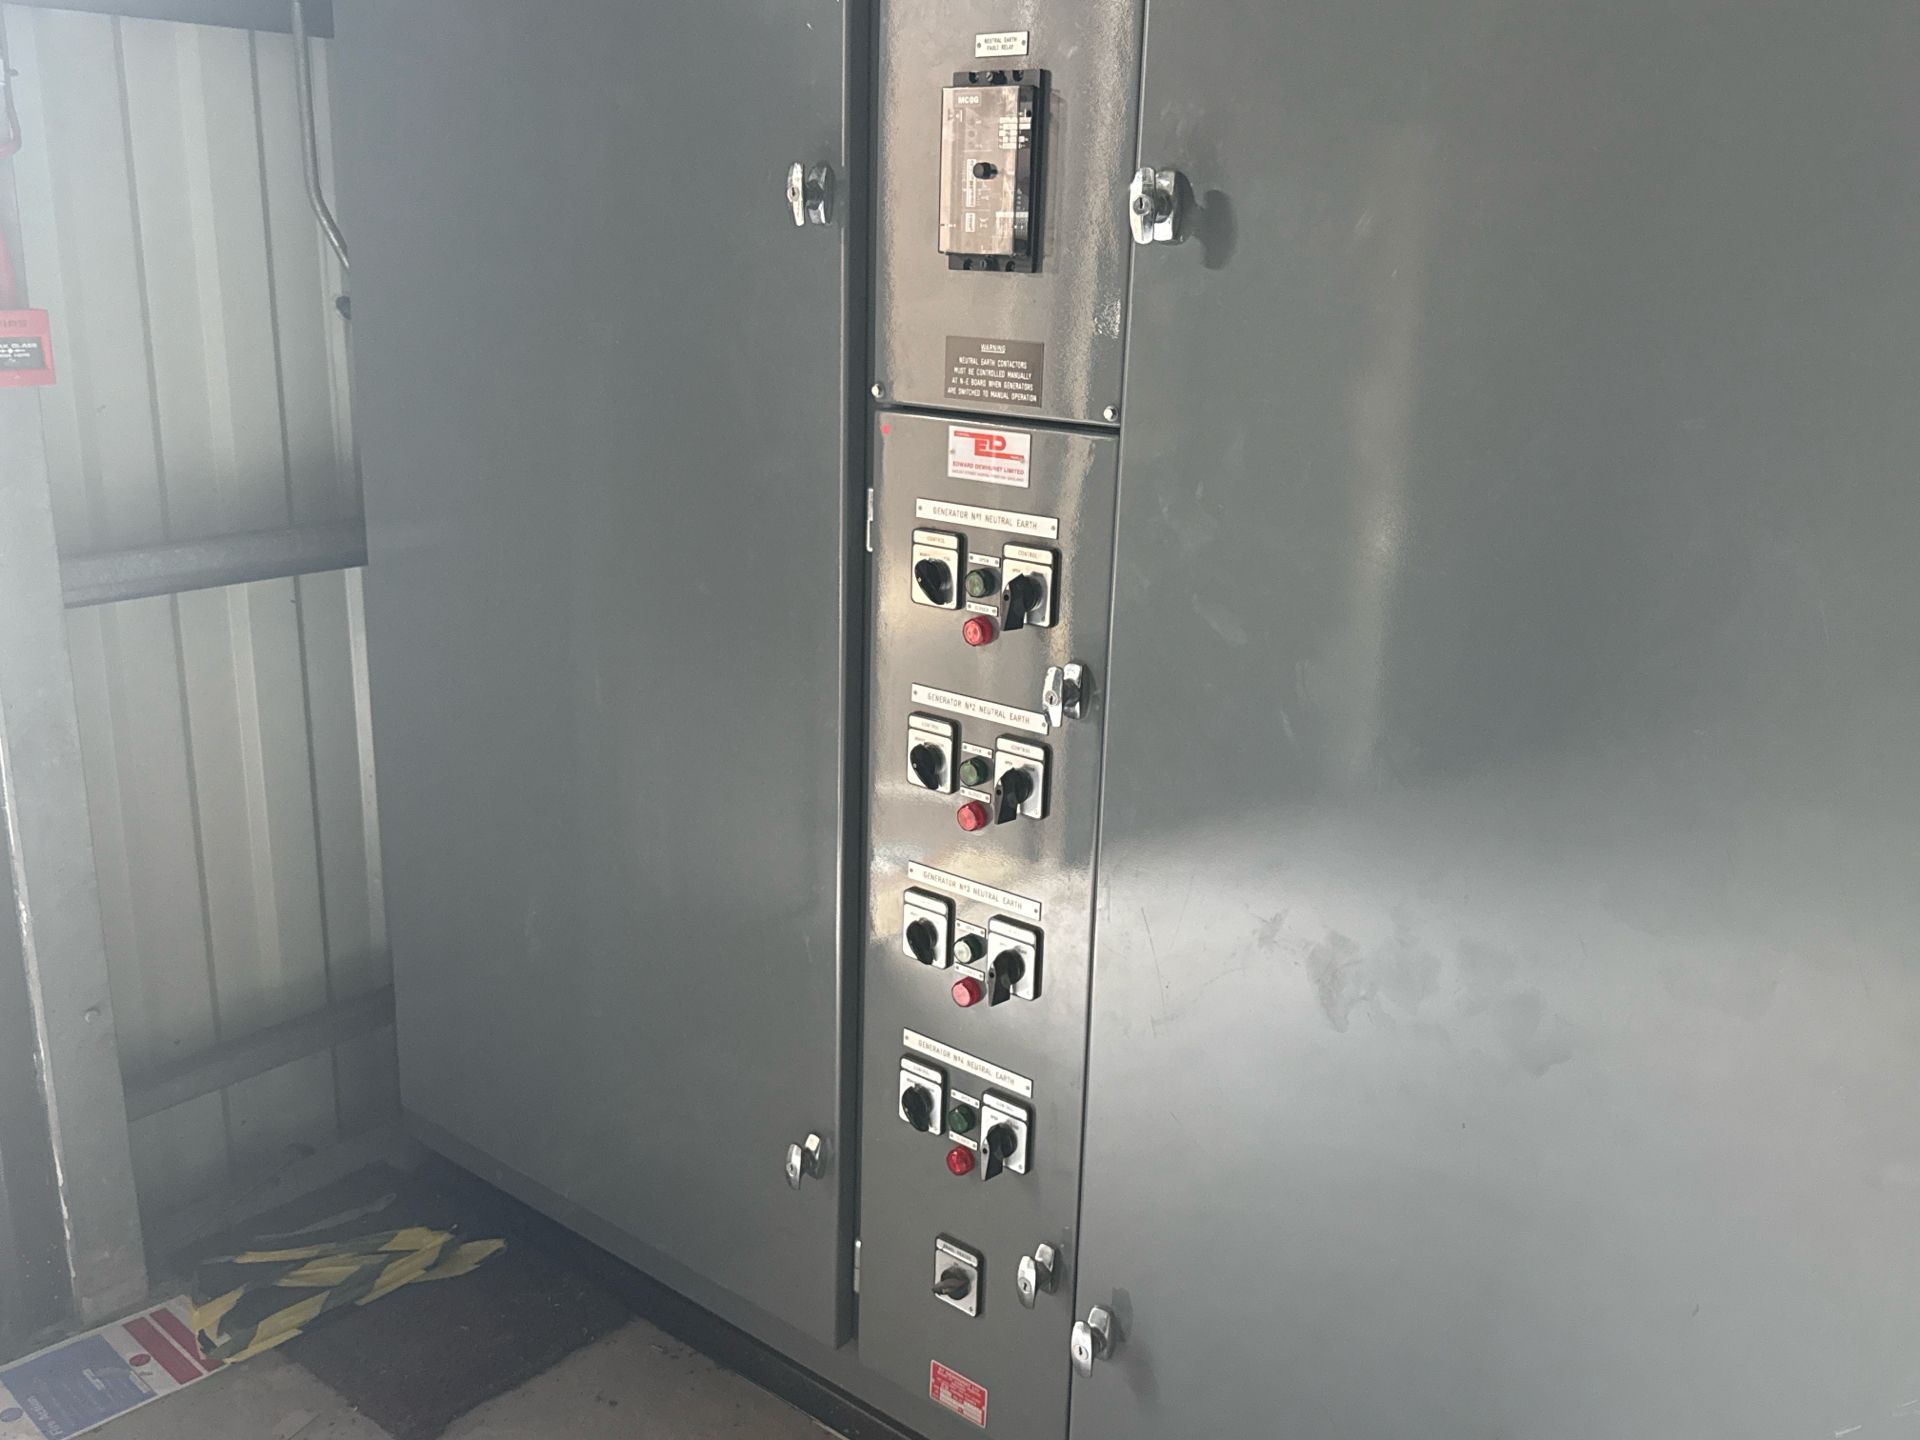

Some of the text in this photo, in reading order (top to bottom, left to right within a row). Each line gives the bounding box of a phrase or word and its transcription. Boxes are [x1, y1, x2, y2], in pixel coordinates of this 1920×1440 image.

[980, 343, 1006, 352] WARNING
[959, 356, 1028, 369] NEUTRAL EARTH CONTACTORS
[953, 366, 1032, 380] MUST BE CONTROLLED MANUALLY
[951, 376, 958, 384] AT
[971, 378, 987, 387] BOARD
[988, 380, 1002, 389] WHEN
[1003, 381, 1034, 391] GENERATORS
[947, 386, 1037, 402] ARE SWITCHED TO MANUAL OPERATION
[953, 461, 974, 469] EDWARD
[1004, 467, 1025, 475] LIMITED
[932, 506, 968, 519] GENERATOR
[984, 514, 1013, 526] NEUTRAL
[1016, 519, 1037, 530] EARTH
[1018, 550, 1038, 559] CONTROL
[927, 693, 962, 707] GENERATOR
[979, 705, 1006, 719] NEUTRAL
[1009, 712, 1030, 724] EARTH
[923, 871, 957, 888] GENERATOR
[973, 887, 999, 902] NEUTRAL
[1002, 896, 1023, 909] EARTH
[918, 1039, 951, 1059] GENERATOR
[967, 1059, 993, 1076] NEUTRAL
[995, 1071, 1015, 1084] EARTH
